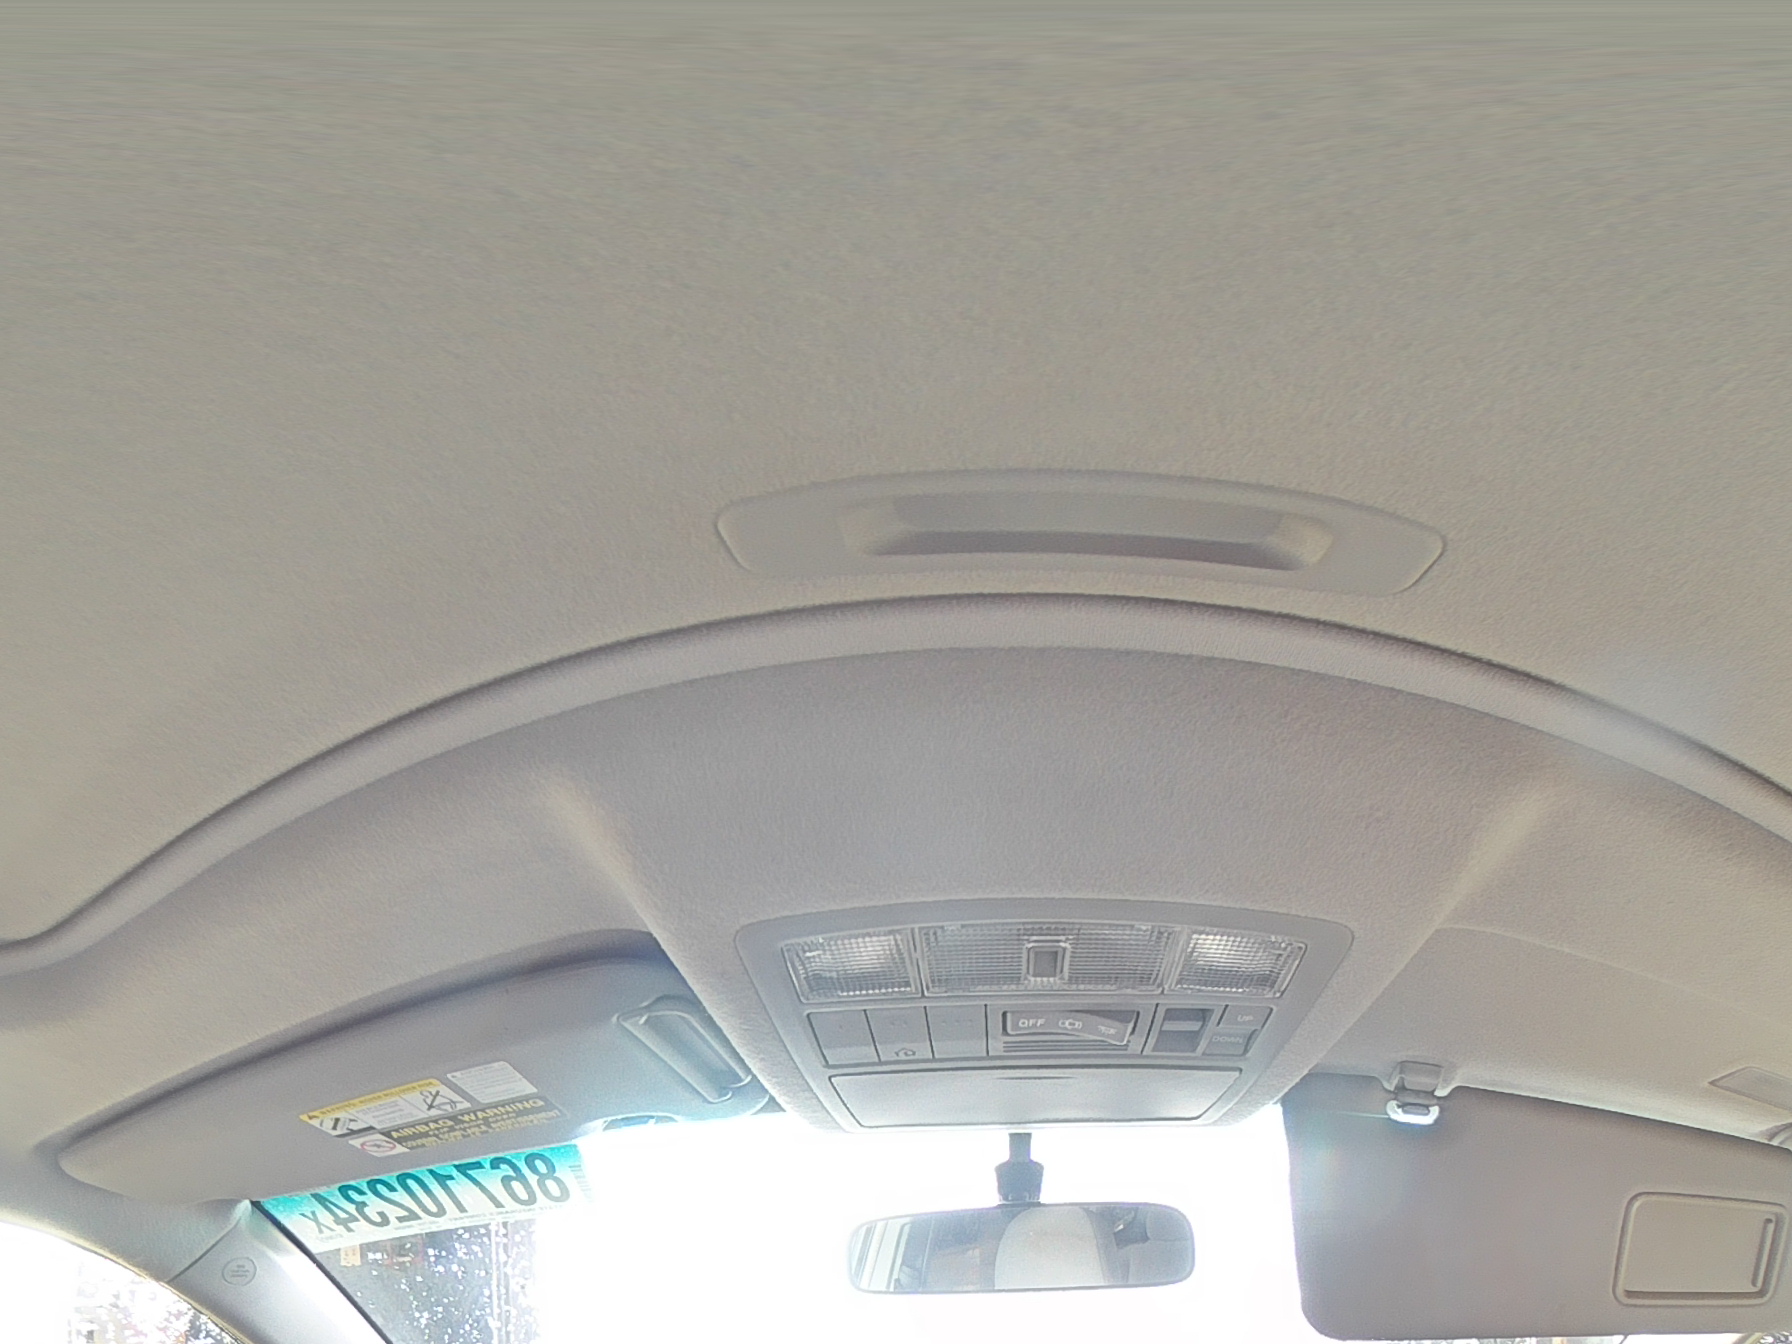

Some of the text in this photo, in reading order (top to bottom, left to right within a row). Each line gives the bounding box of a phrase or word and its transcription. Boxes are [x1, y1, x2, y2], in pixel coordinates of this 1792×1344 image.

[1018, 1018, 1046, 1028] OFF
[1236, 1014, 1254, 1023] UP
[1211, 1035, 1244, 1044] DOWN
[390, 1118, 455, 1139] AIRBAG
[457, 1098, 545, 1123] WARNING
